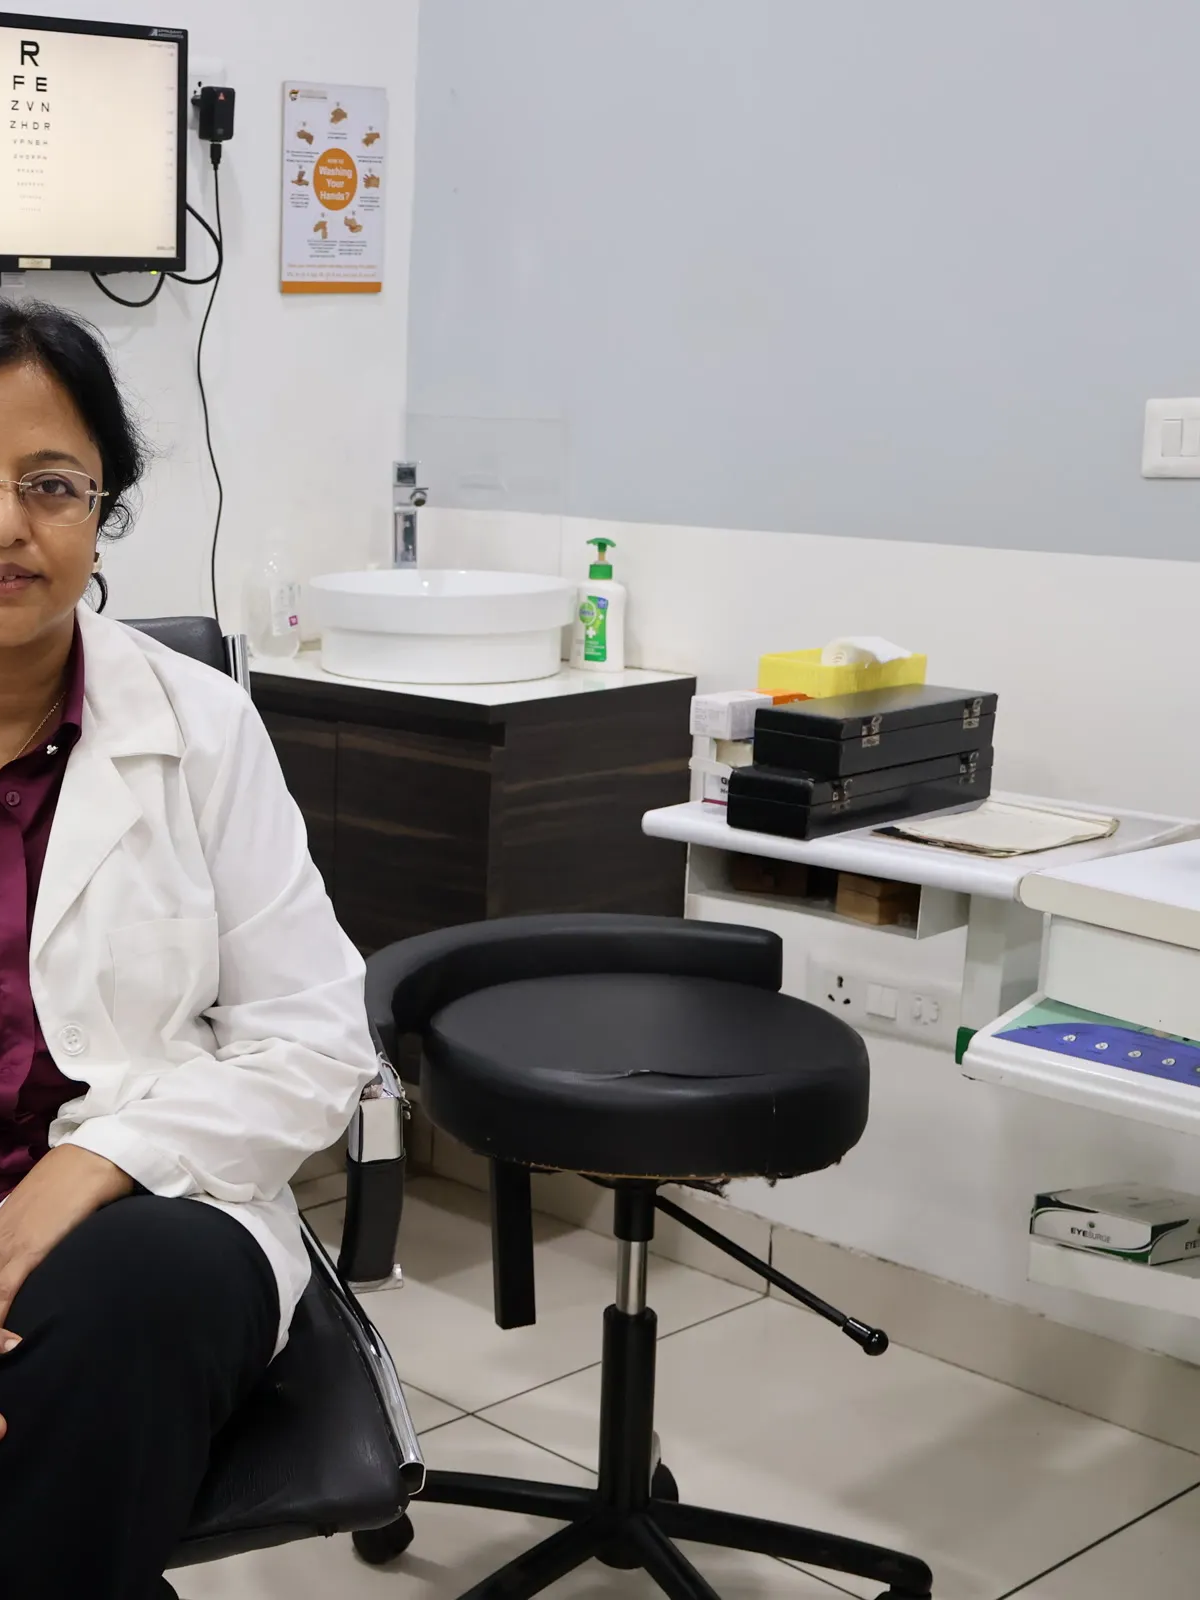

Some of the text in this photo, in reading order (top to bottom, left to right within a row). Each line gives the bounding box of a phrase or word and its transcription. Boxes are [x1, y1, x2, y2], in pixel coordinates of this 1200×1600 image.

[21, 40, 39, 66] R
[319, 165, 353, 179] Washing
[325, 178, 345, 188] Your
[320, 190, 350, 201] Hands?
[1070, 1227, 1112, 1243] EYESURGE
